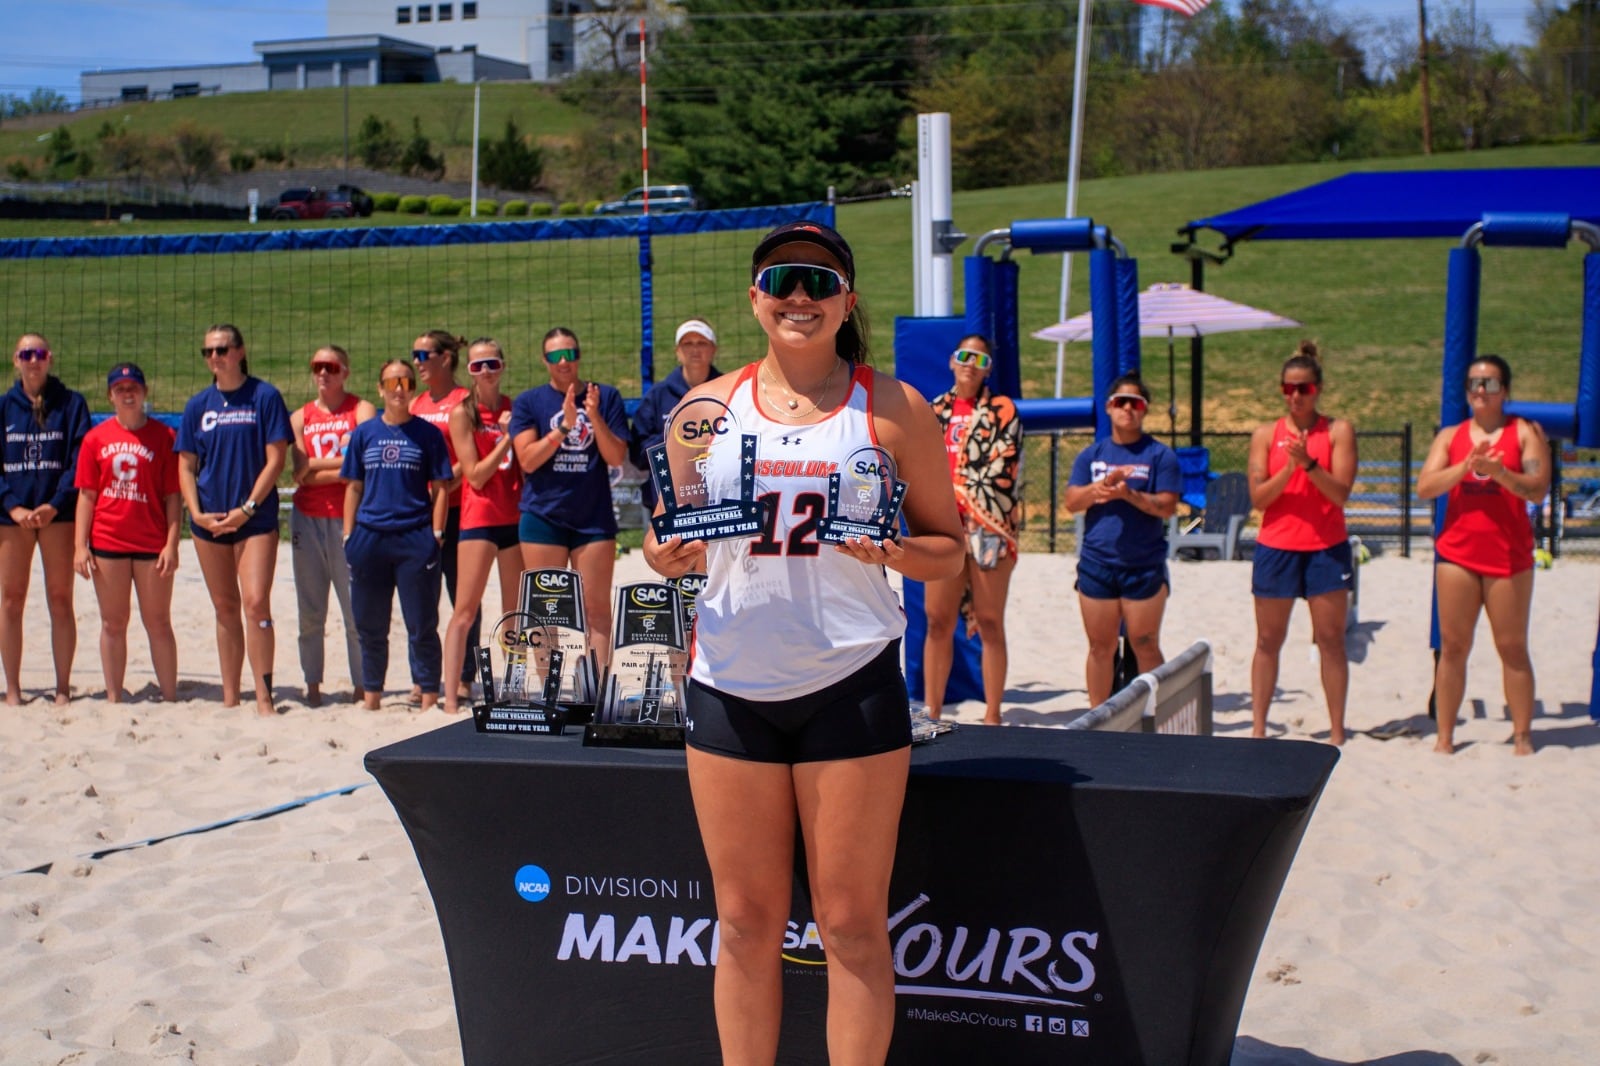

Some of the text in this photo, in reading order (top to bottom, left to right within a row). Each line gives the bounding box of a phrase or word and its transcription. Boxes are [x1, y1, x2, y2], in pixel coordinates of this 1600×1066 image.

[201, 410, 218, 432] C
[304, 420, 350, 436] CATAWBA
[682, 416, 730, 440] SAC
[101, 441, 154, 462] CATAWBA
[311, 433, 340, 459] 12
[112, 452, 138, 480] C
[753, 459, 839, 478] SCULUM
[854, 461, 889, 478] SAC
[673, 510, 742, 527] BEACH VOLLEYBALL
[749, 490, 828, 557] 12
[706, 528, 717, 536] OF
[718, 524, 735, 535] THE
[736, 521, 758, 532] YEAR
[540, 573, 569, 587] SAC
[636, 587, 668, 602] SAC
[504, 629, 542, 647] SAC
[510, 712, 546, 722] VOLLEYBALL
[485, 722, 550, 733] COACH OF THE YEAR
[518, 881, 550, 894] NCAA
[565, 875, 678, 899] DIVISION
[782, 920, 825, 950] SA
[906, 1007, 1018, 1029] #MakeSACYours
